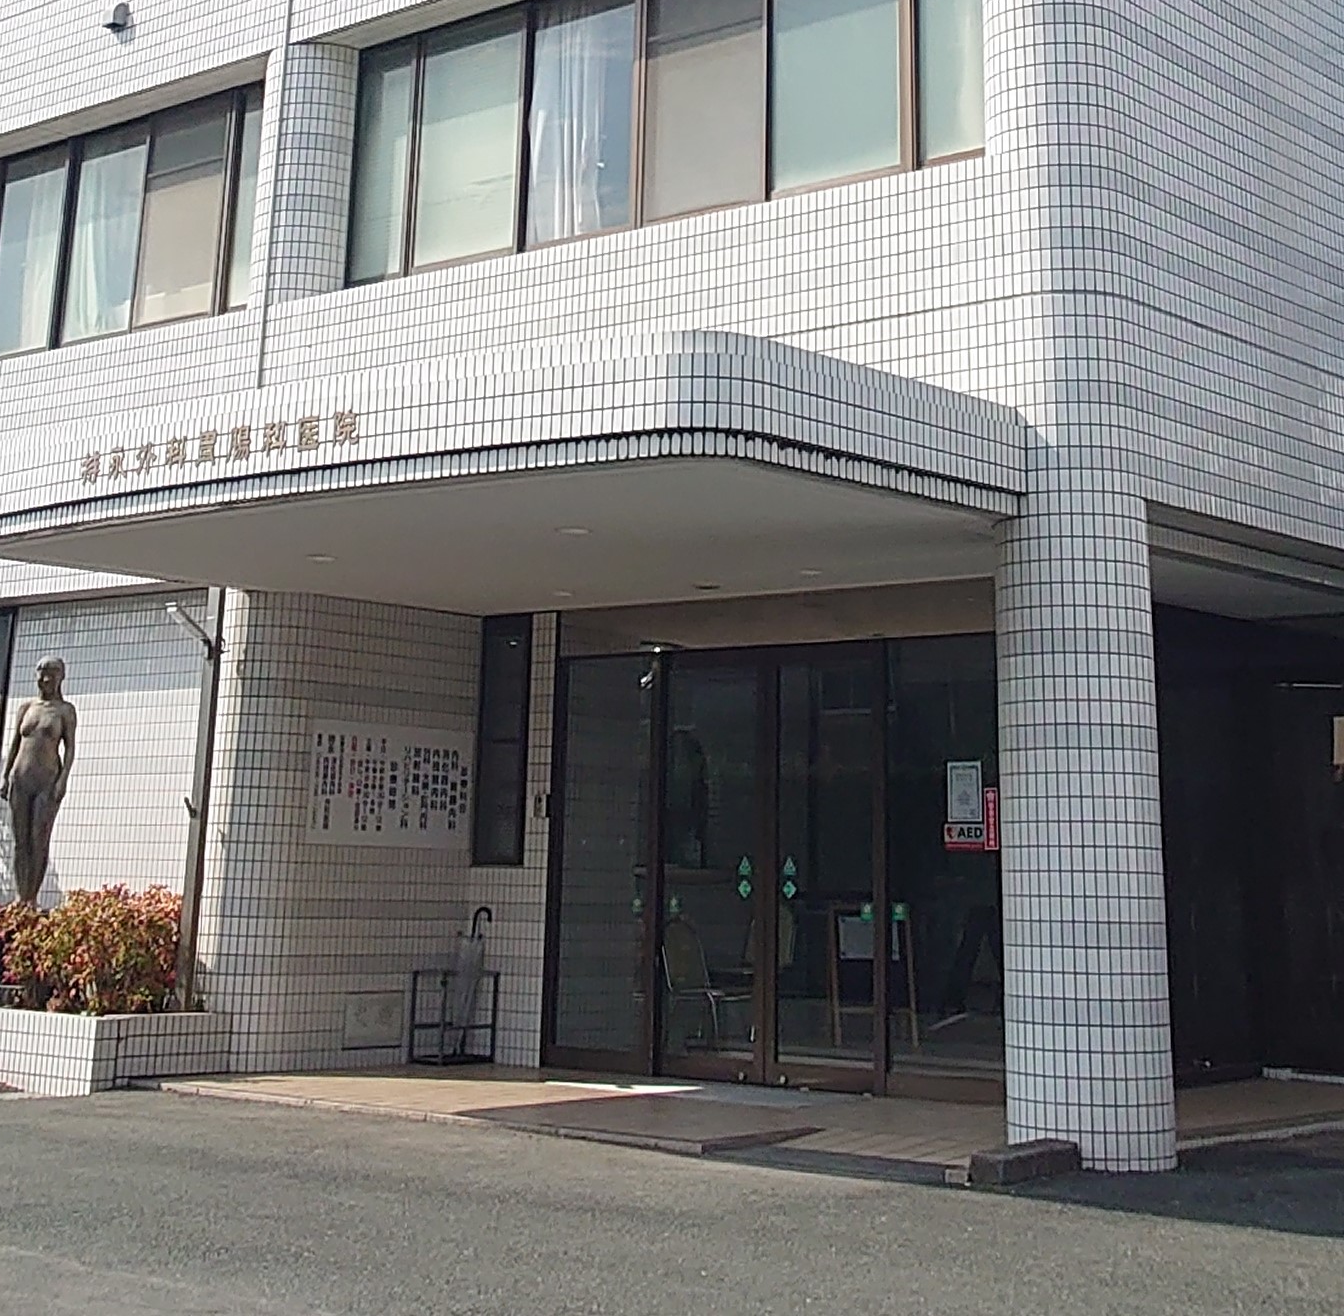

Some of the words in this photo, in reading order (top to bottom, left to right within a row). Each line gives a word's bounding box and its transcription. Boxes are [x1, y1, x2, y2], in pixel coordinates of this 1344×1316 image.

[80, 409, 360, 486] 持永外科胃腸科医院
[957, 827, 983, 839] AED
